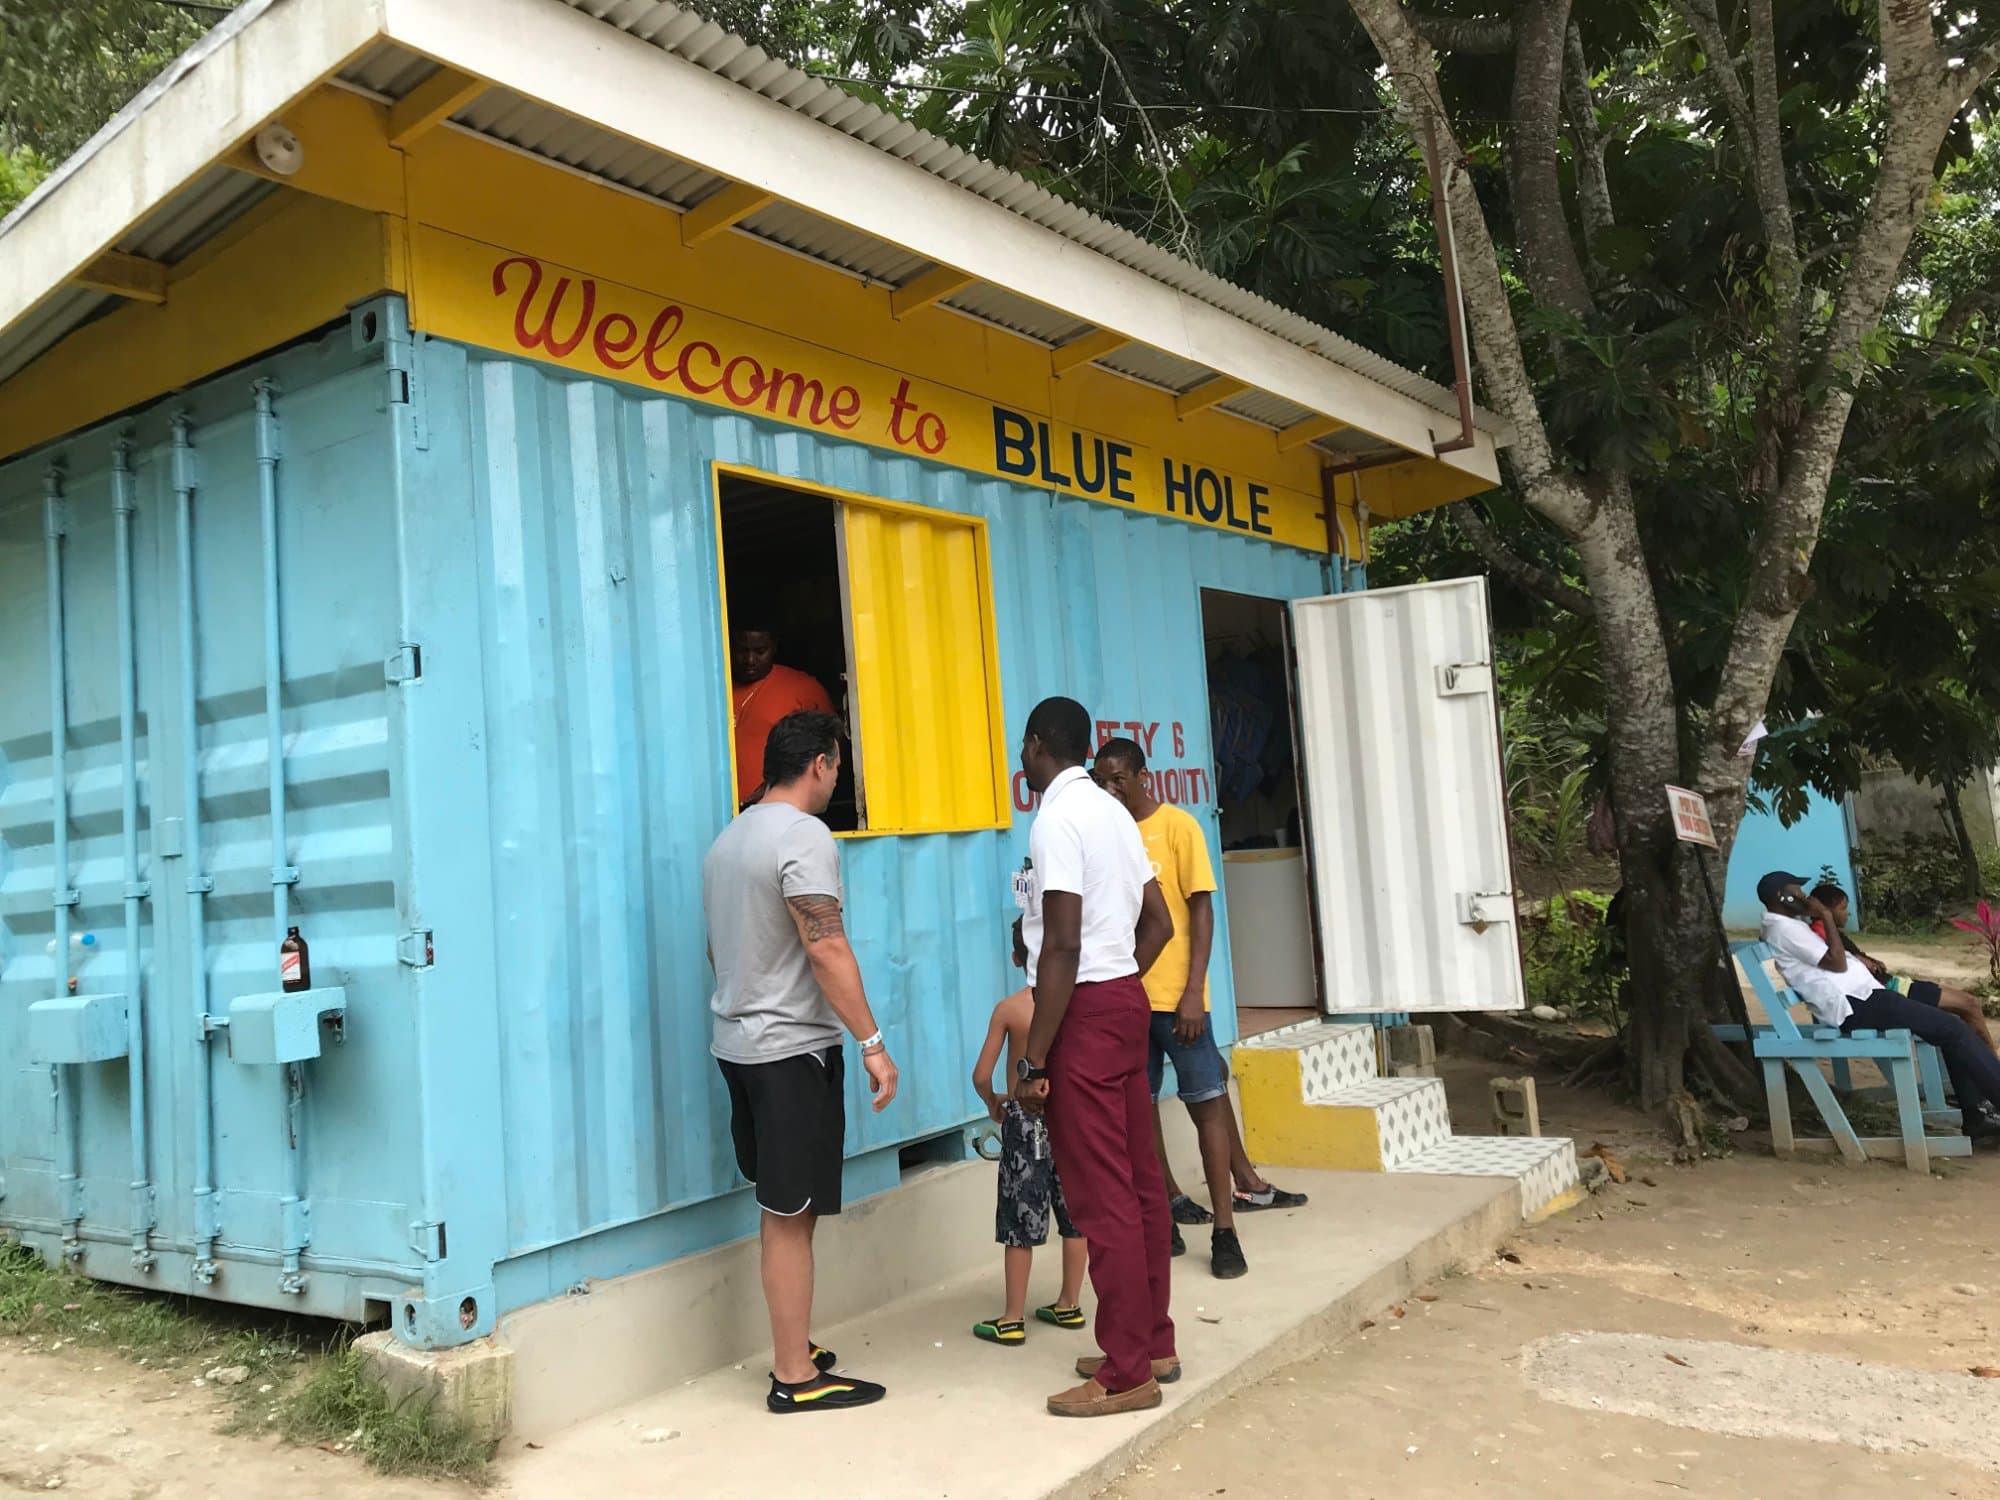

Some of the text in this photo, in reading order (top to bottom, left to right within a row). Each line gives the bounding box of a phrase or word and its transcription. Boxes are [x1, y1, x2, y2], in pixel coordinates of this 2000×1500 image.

[492, 256, 1273, 535] Welcome to BLUE HOLE
[1087, 720, 1160, 759] FTY
